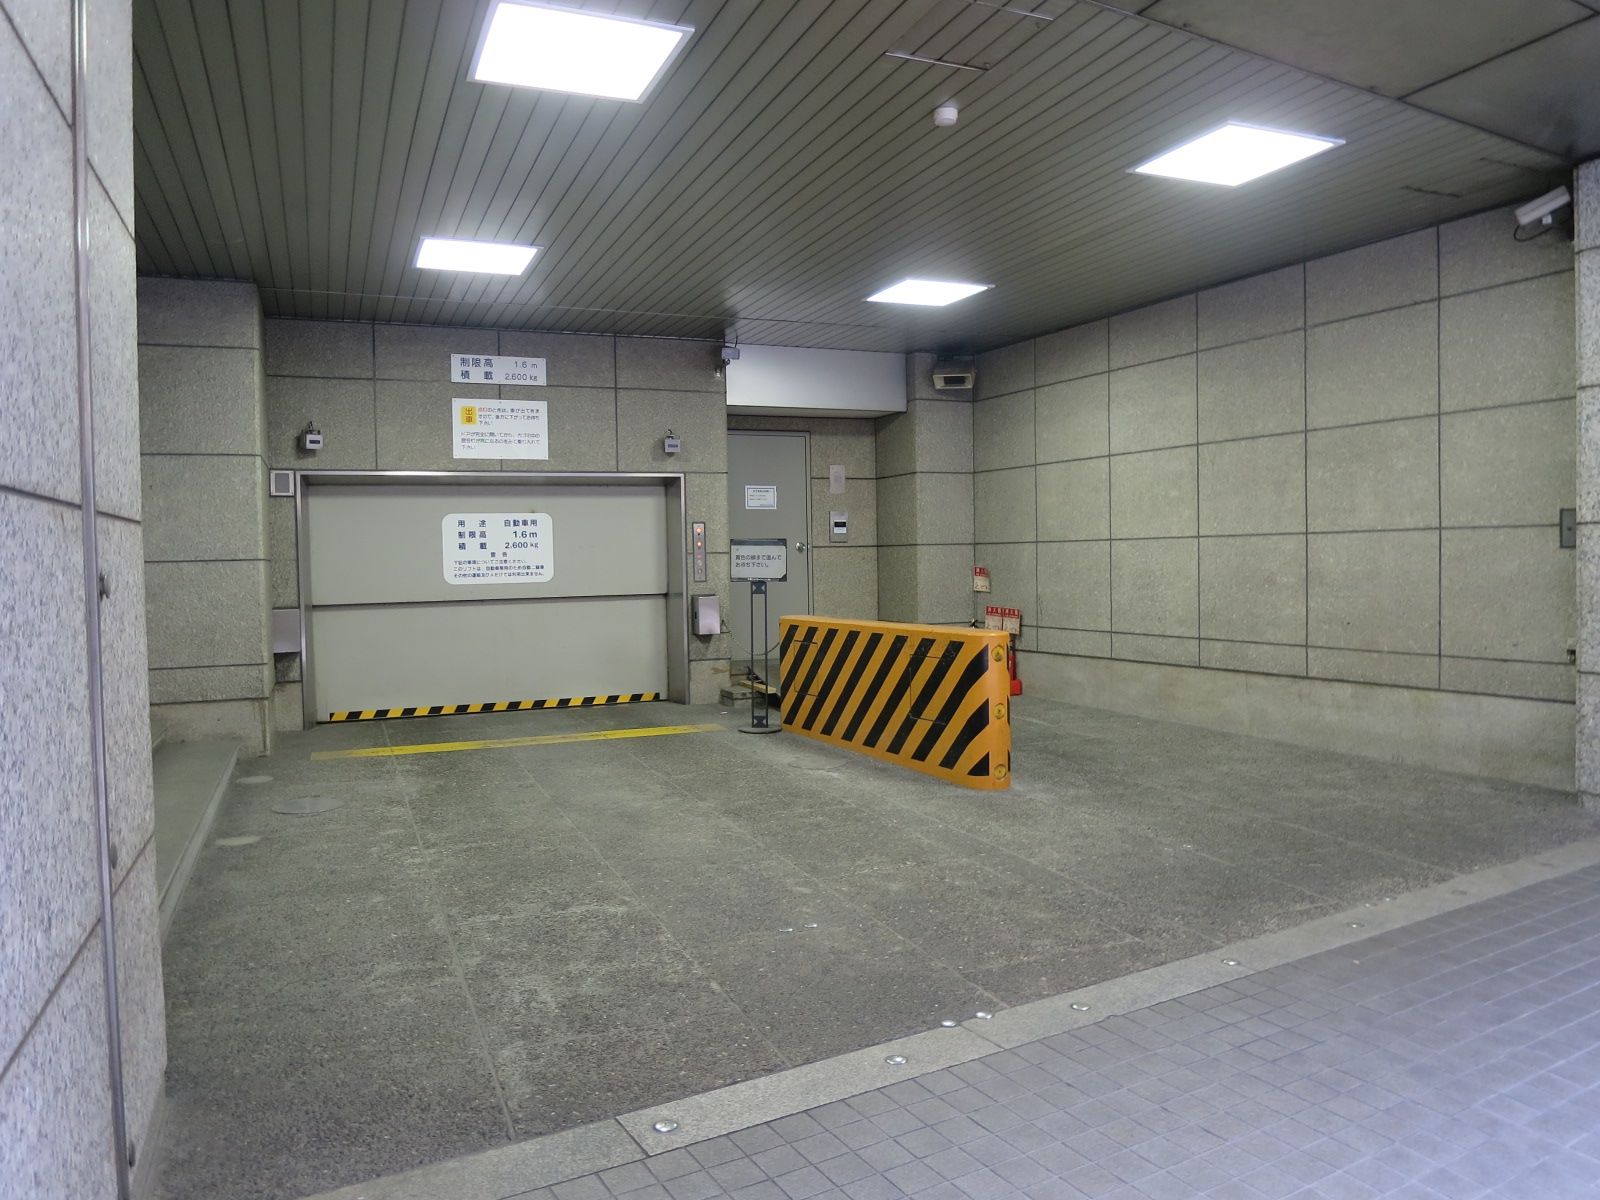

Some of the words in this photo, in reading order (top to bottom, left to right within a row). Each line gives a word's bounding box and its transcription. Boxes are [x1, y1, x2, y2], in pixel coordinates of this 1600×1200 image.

[460, 357, 493, 368] 制限高
[504, 519, 538, 527] 自動車用
[458, 531, 487, 539] 制限高
